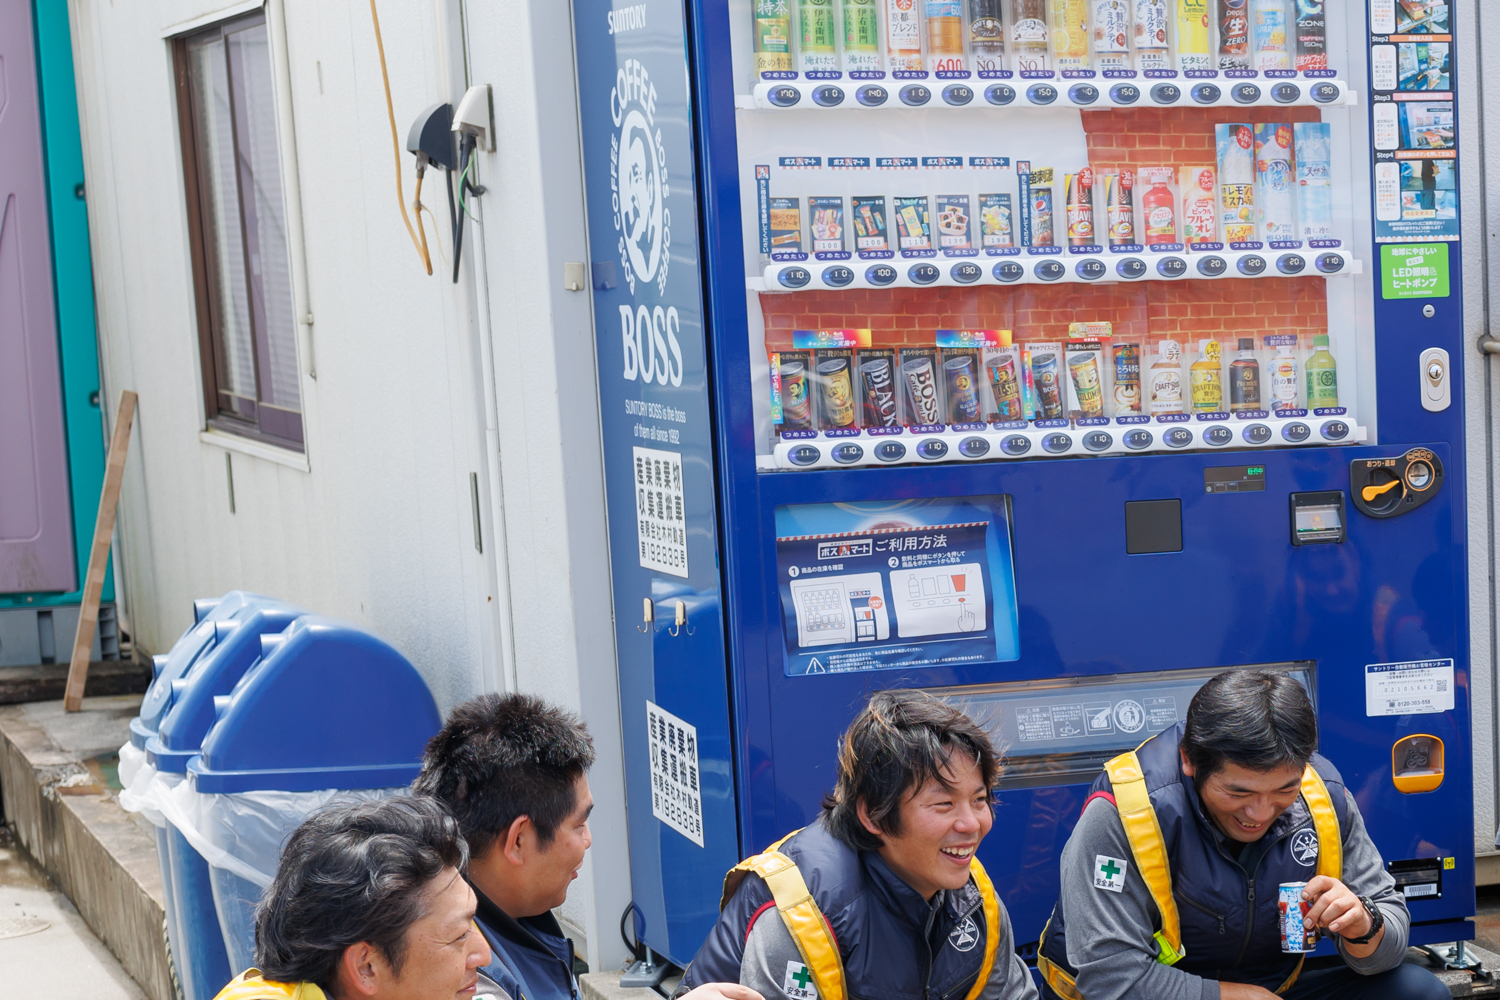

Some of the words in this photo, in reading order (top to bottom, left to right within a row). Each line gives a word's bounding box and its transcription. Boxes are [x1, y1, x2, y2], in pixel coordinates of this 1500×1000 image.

[758, 0, 788, 16] 特茶
[608, 4, 647, 35] SUNTORY
[814, 8, 825, 44] 伊右衛門
[858, 8, 868, 44] 伊右衛門
[1228, 18, 1243, 36] 生
[1226, 36, 1246, 46] ZERO
[611, 59, 657, 127] COFFEE
[1392, 247, 1438, 256] 地球にやさしい
[1392, 266, 1438, 278] LED照明&
[1392, 278, 1438, 288] ヒートポンプ
[620, 304, 683, 388] BOSS
[1117, 364, 1139, 373] とろける
[1155, 382, 1170, 392] CRAFT
[1193, 384, 1210, 394] CRAFT
[870, 366, 897, 428] BLACK
[916, 368, 938, 425] BOSS
[625, 399, 648, 417] SUNTORY
[648, 402, 662, 420] BOSS
[674, 406, 686, 424] boss
[656, 426, 668, 442] since
[669, 428, 680, 444] 1992
[875, 534, 948, 552] ご利用方法
[802, 564, 844, 574] 商品の在庫を確認
[1096, 878, 1121, 888] 安全第一
[786, 986, 816, 998] 安全第一
